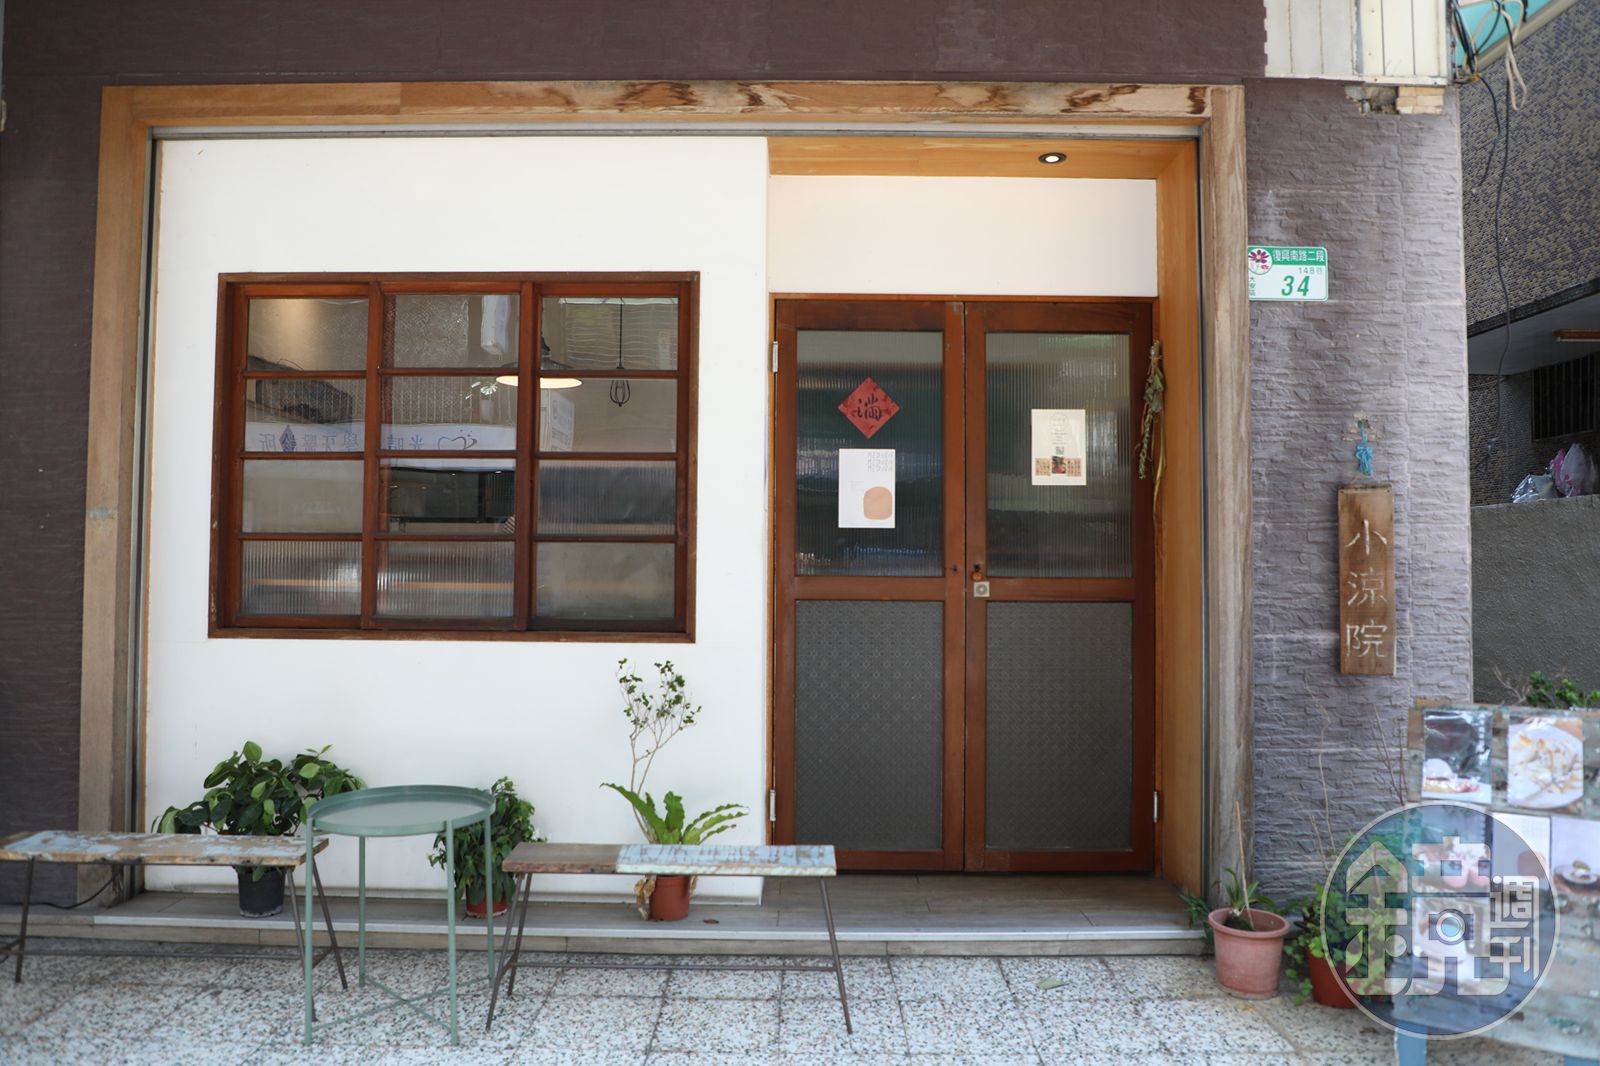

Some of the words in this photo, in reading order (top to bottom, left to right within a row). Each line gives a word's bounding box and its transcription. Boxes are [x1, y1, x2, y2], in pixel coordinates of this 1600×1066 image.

[1273, 249, 1325, 262] 復興南路二段
[1281, 275, 1310, 297] 34
[1345, 519, 1389, 658] 小涼院
